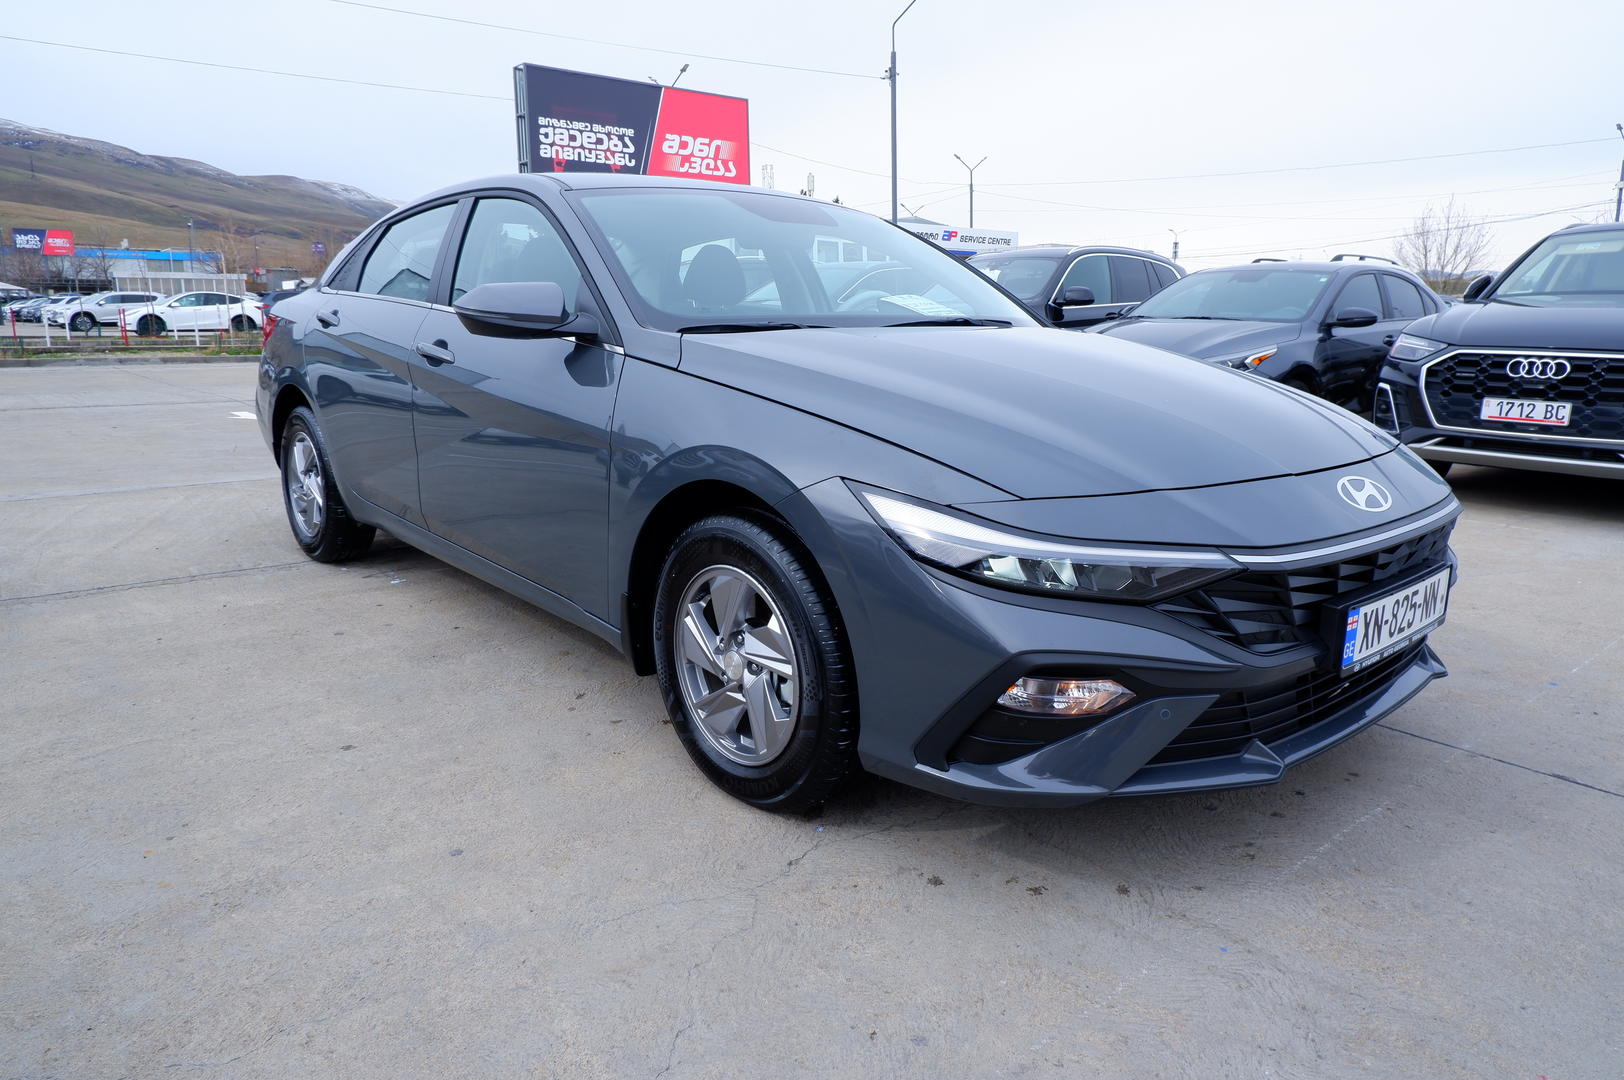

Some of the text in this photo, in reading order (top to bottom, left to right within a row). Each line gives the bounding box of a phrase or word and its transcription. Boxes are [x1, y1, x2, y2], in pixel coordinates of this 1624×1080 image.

[539, 127, 636, 154] ქმედება
[539, 144, 636, 167] მიგიყვანს
[960, 234, 987, 244] SERVICE
[987, 237, 1012, 246] CENTRE
[1496, 401, 1566, 421] 1712 BC
[1358, 577, 1441, 654] XN-825-NN
[1344, 640, 1355, 659] GE
